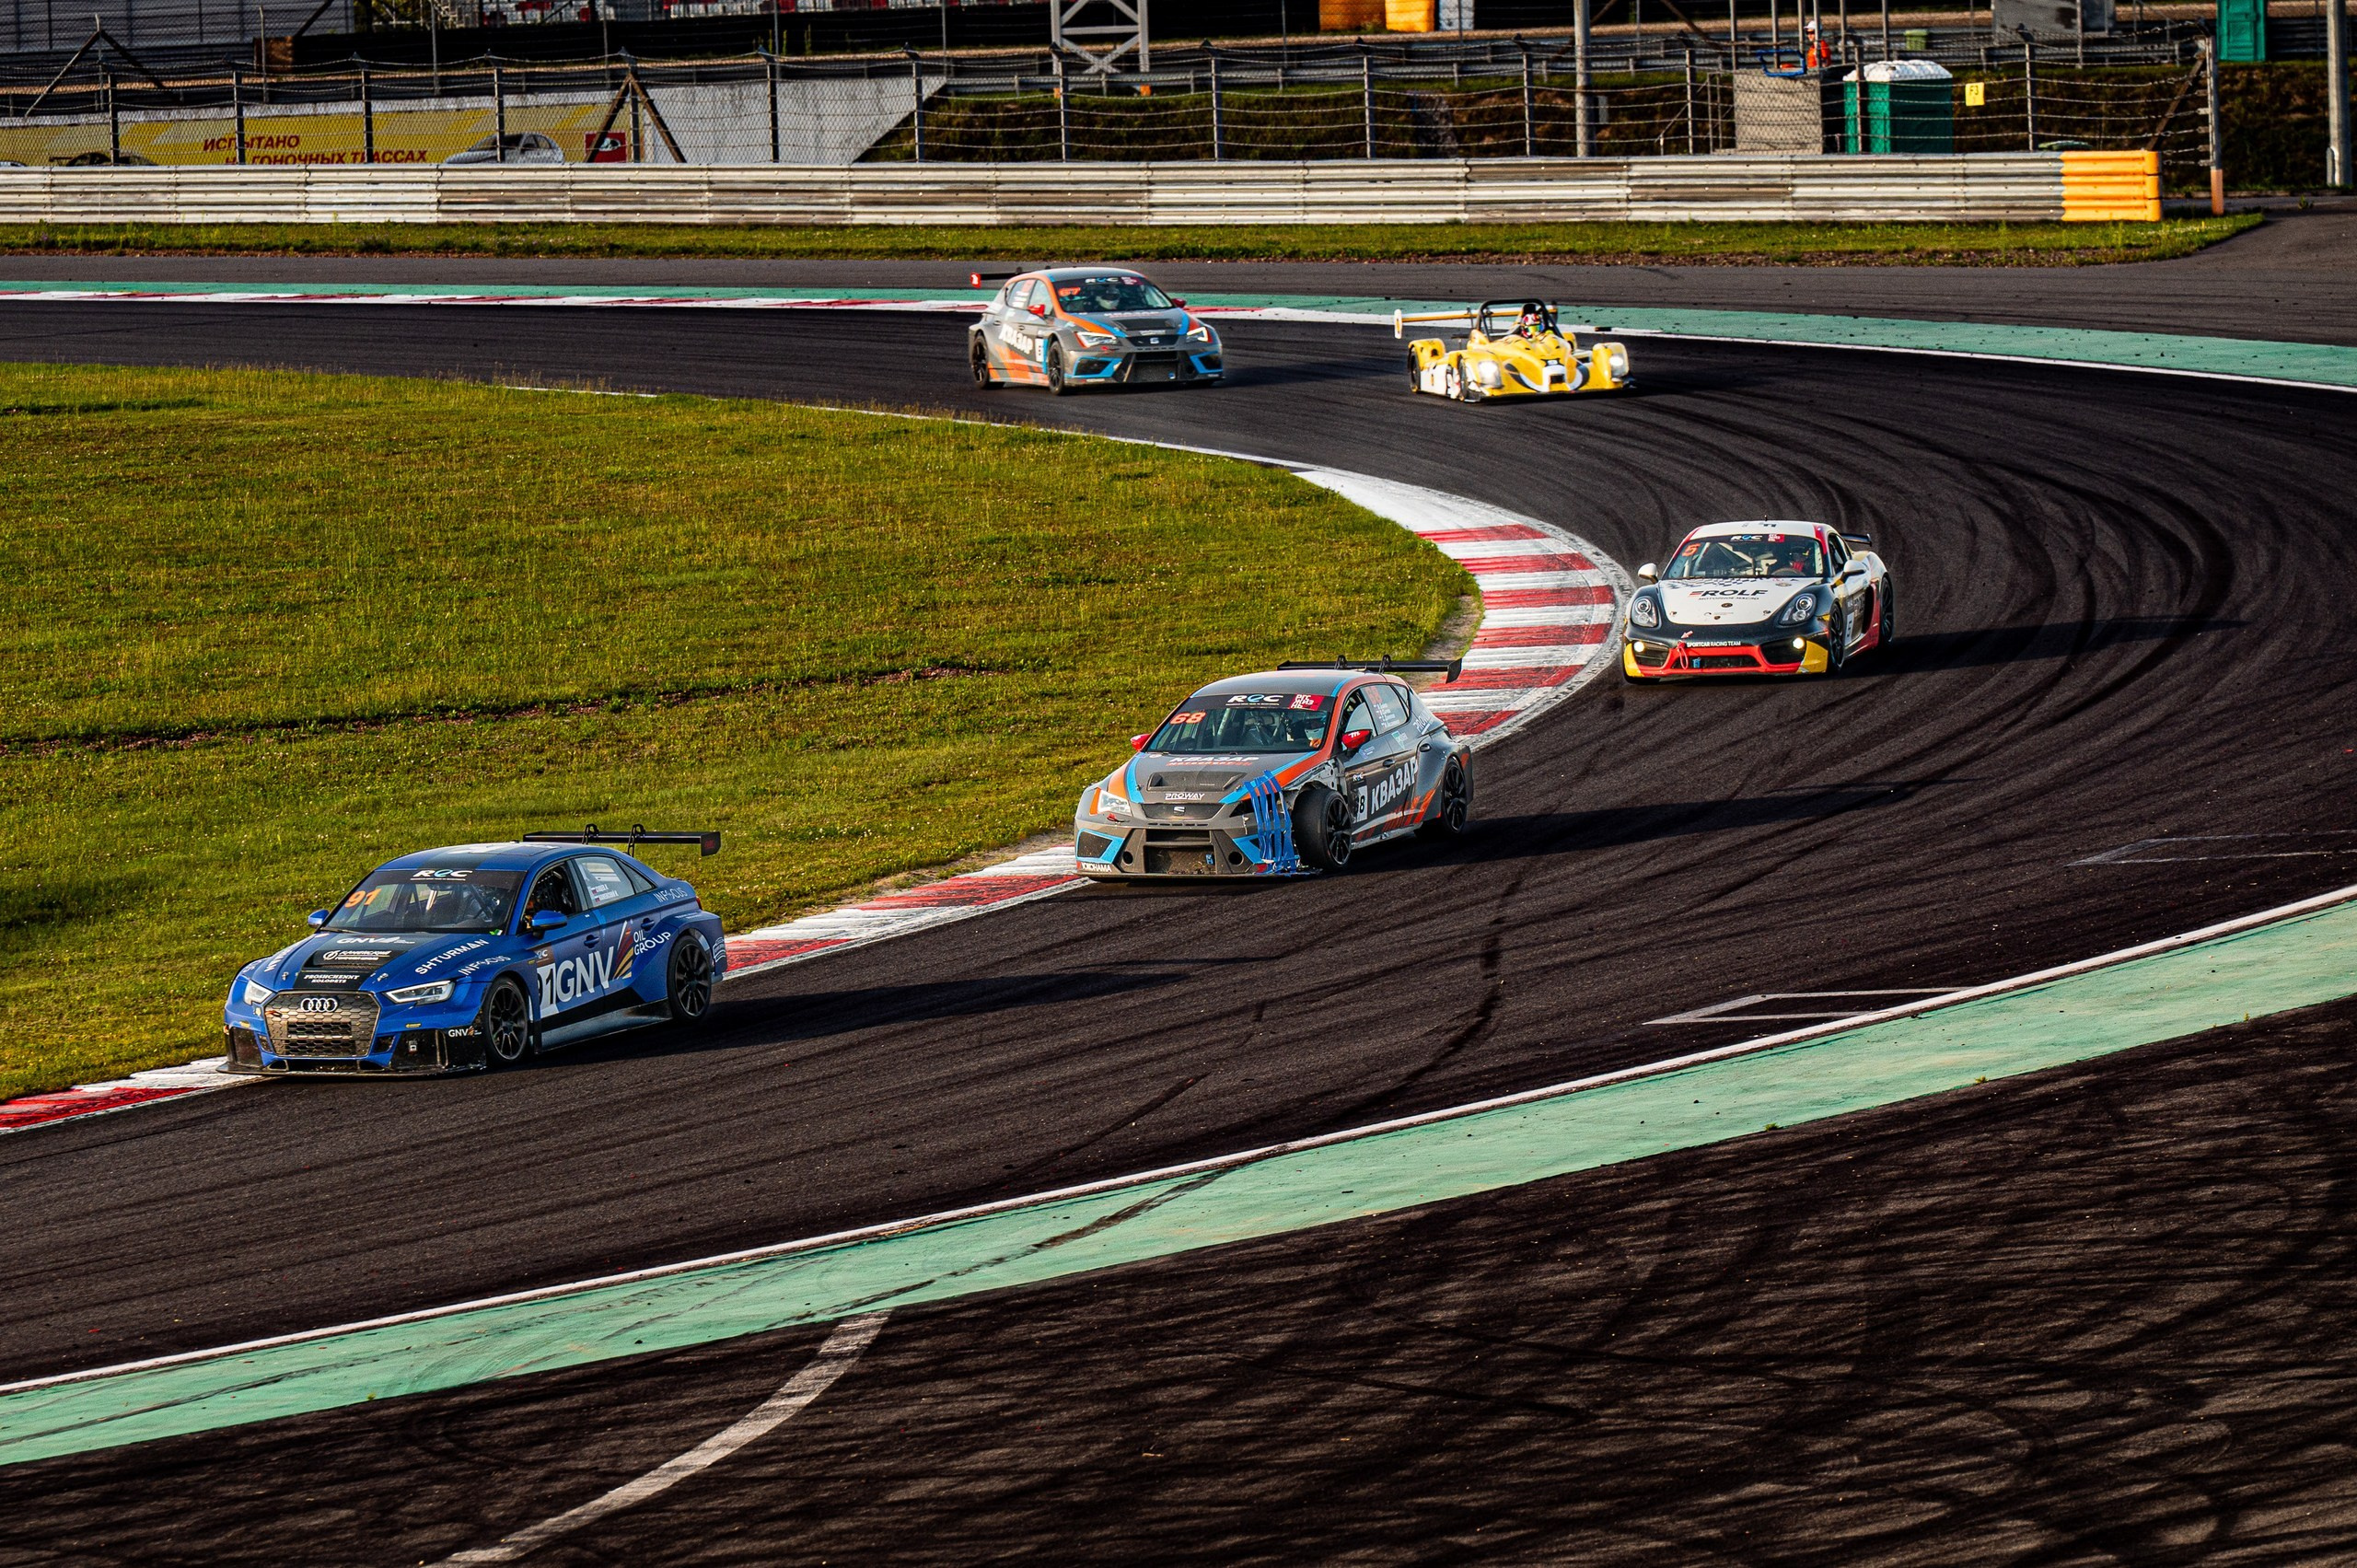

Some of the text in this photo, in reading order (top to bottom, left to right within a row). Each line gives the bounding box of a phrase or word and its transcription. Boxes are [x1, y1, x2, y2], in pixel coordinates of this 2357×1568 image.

[1682, 542, 1701, 557] 5
[1169, 712, 1207, 725] 68
[1371, 756, 1418, 815] КВАЗАР
[1165, 793, 1205, 801] PROWAY
[344, 888, 382, 909] 91
[633, 930, 646, 944] OIL
[634, 932, 671, 955] GROUP
[415, 939, 490, 975] SHTURMAN
[557, 947, 614, 1002] GNV
[448, 1028, 468, 1038] GNV
